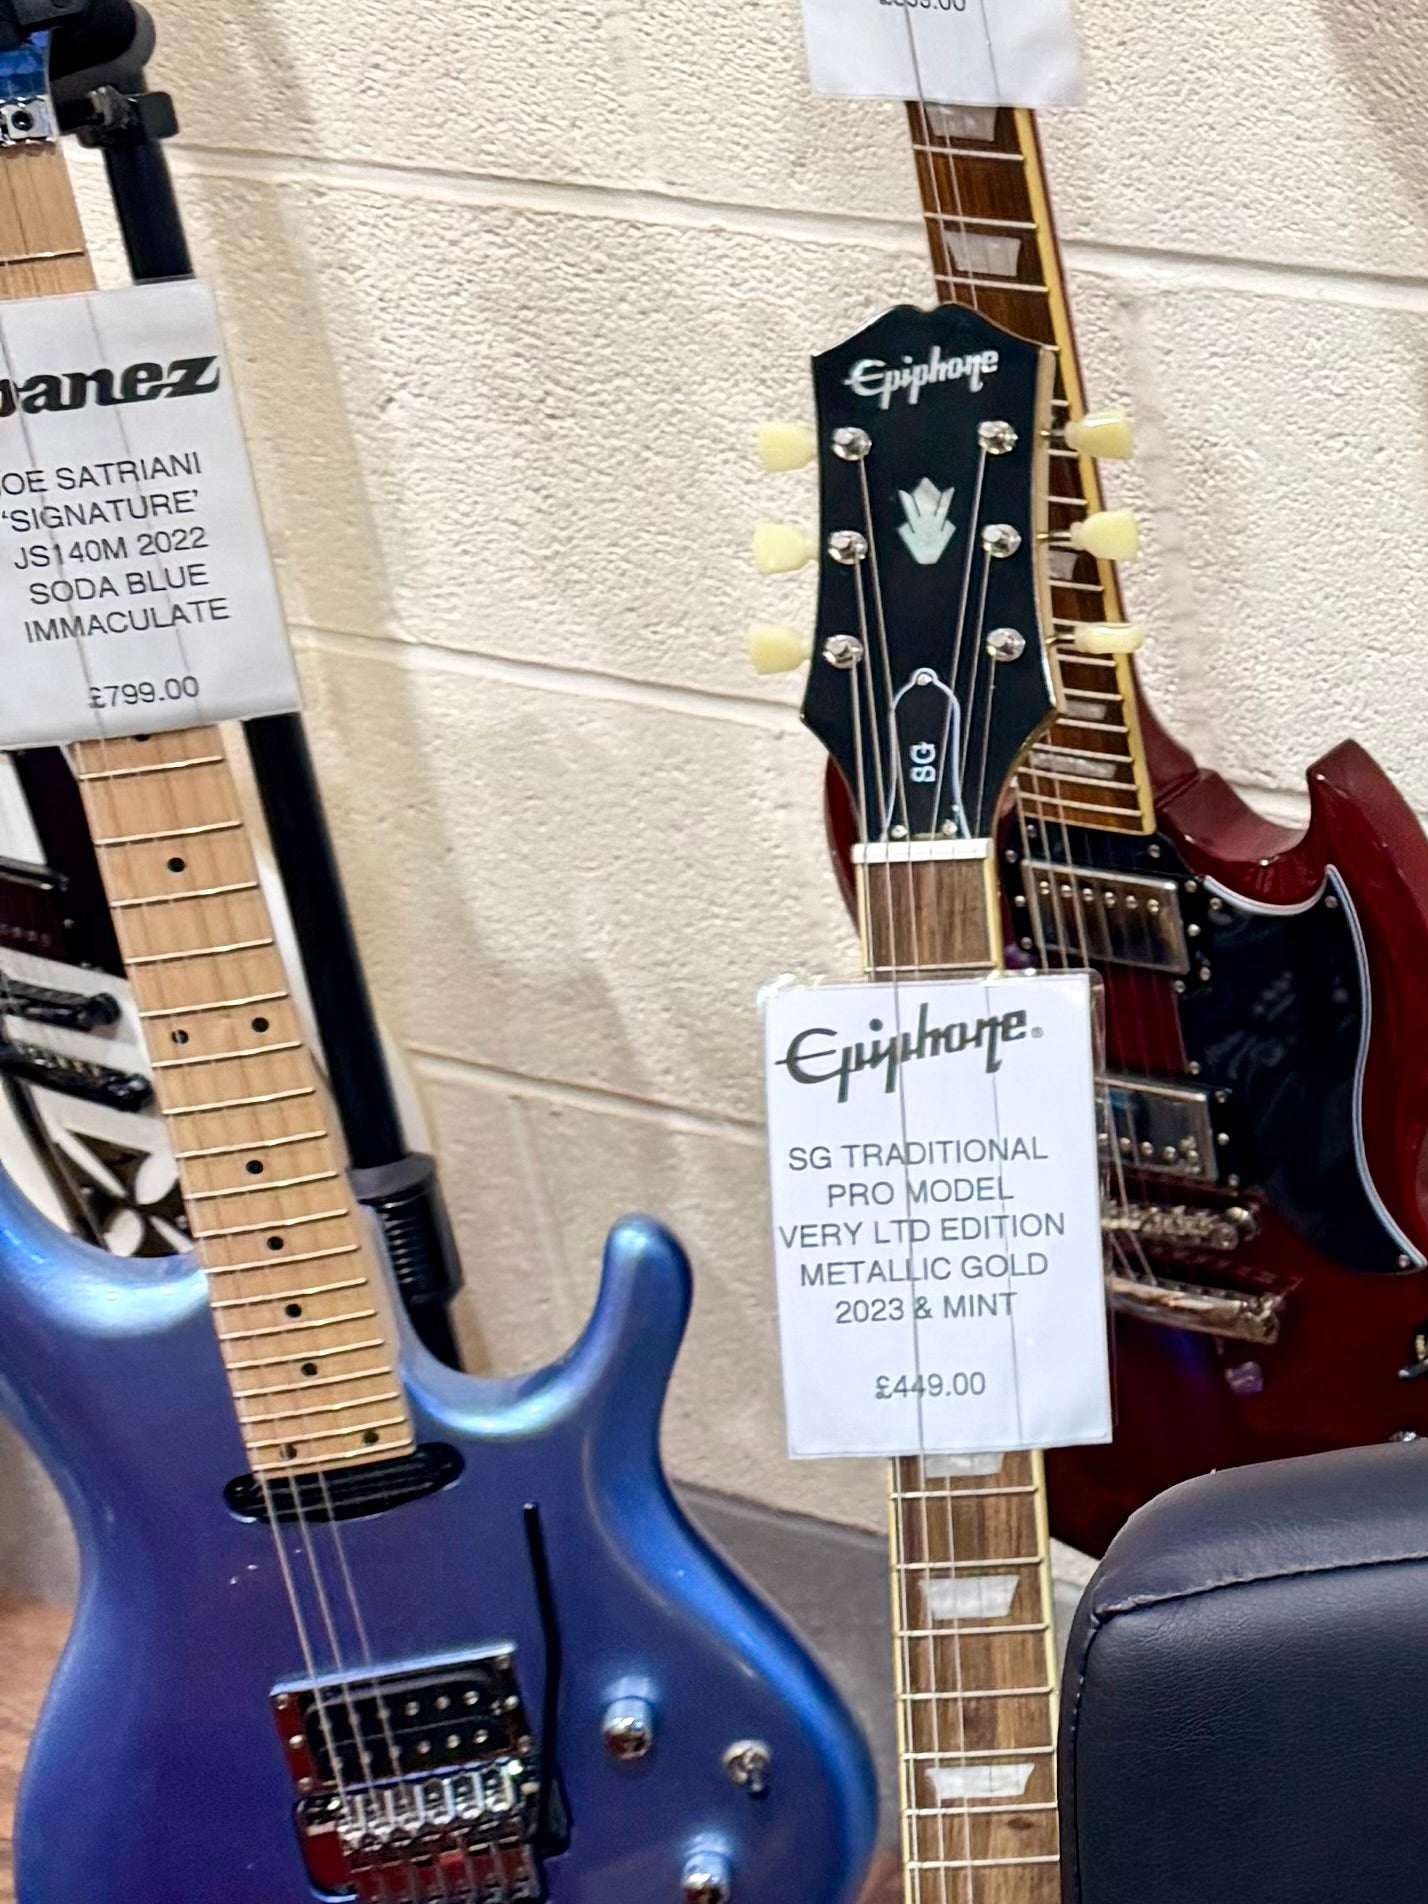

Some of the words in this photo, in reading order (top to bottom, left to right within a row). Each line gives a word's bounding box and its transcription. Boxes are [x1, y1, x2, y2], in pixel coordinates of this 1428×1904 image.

[843, 345, 1000, 409] Epiphone
[0, 470, 47, 497] OE
[55, 451, 203, 491] SATRIANI
[15, 535, 128, 570] JS140M
[137, 526, 209, 556] 2022
[30, 576, 119, 606] SODA
[126, 563, 211, 595] BLUE
[25, 597, 231, 644] IMMACULATE
[89, 676, 200, 710] £799.00
[909, 741, 936, 783] SG
[789, 1146, 832, 1172] SG
[841, 1136, 1049, 1168] TRADITIONAL
[827, 1181, 894, 1208] PRO
[904, 1175, 1014, 1206] MODEL
[778, 1221, 863, 1250] VERY
[873, 1218, 931, 1245] LTD
[941, 1212, 1066, 1243] EDITION
[801, 1256, 952, 1287] METALLIC
[961, 1251, 1049, 1280] GOLD
[835, 1299, 904, 1325] 2023
[913, 1297, 933, 1321] &
[943, 1292, 1018, 1320] MINT
[875, 1371, 986, 1400] £449.00
